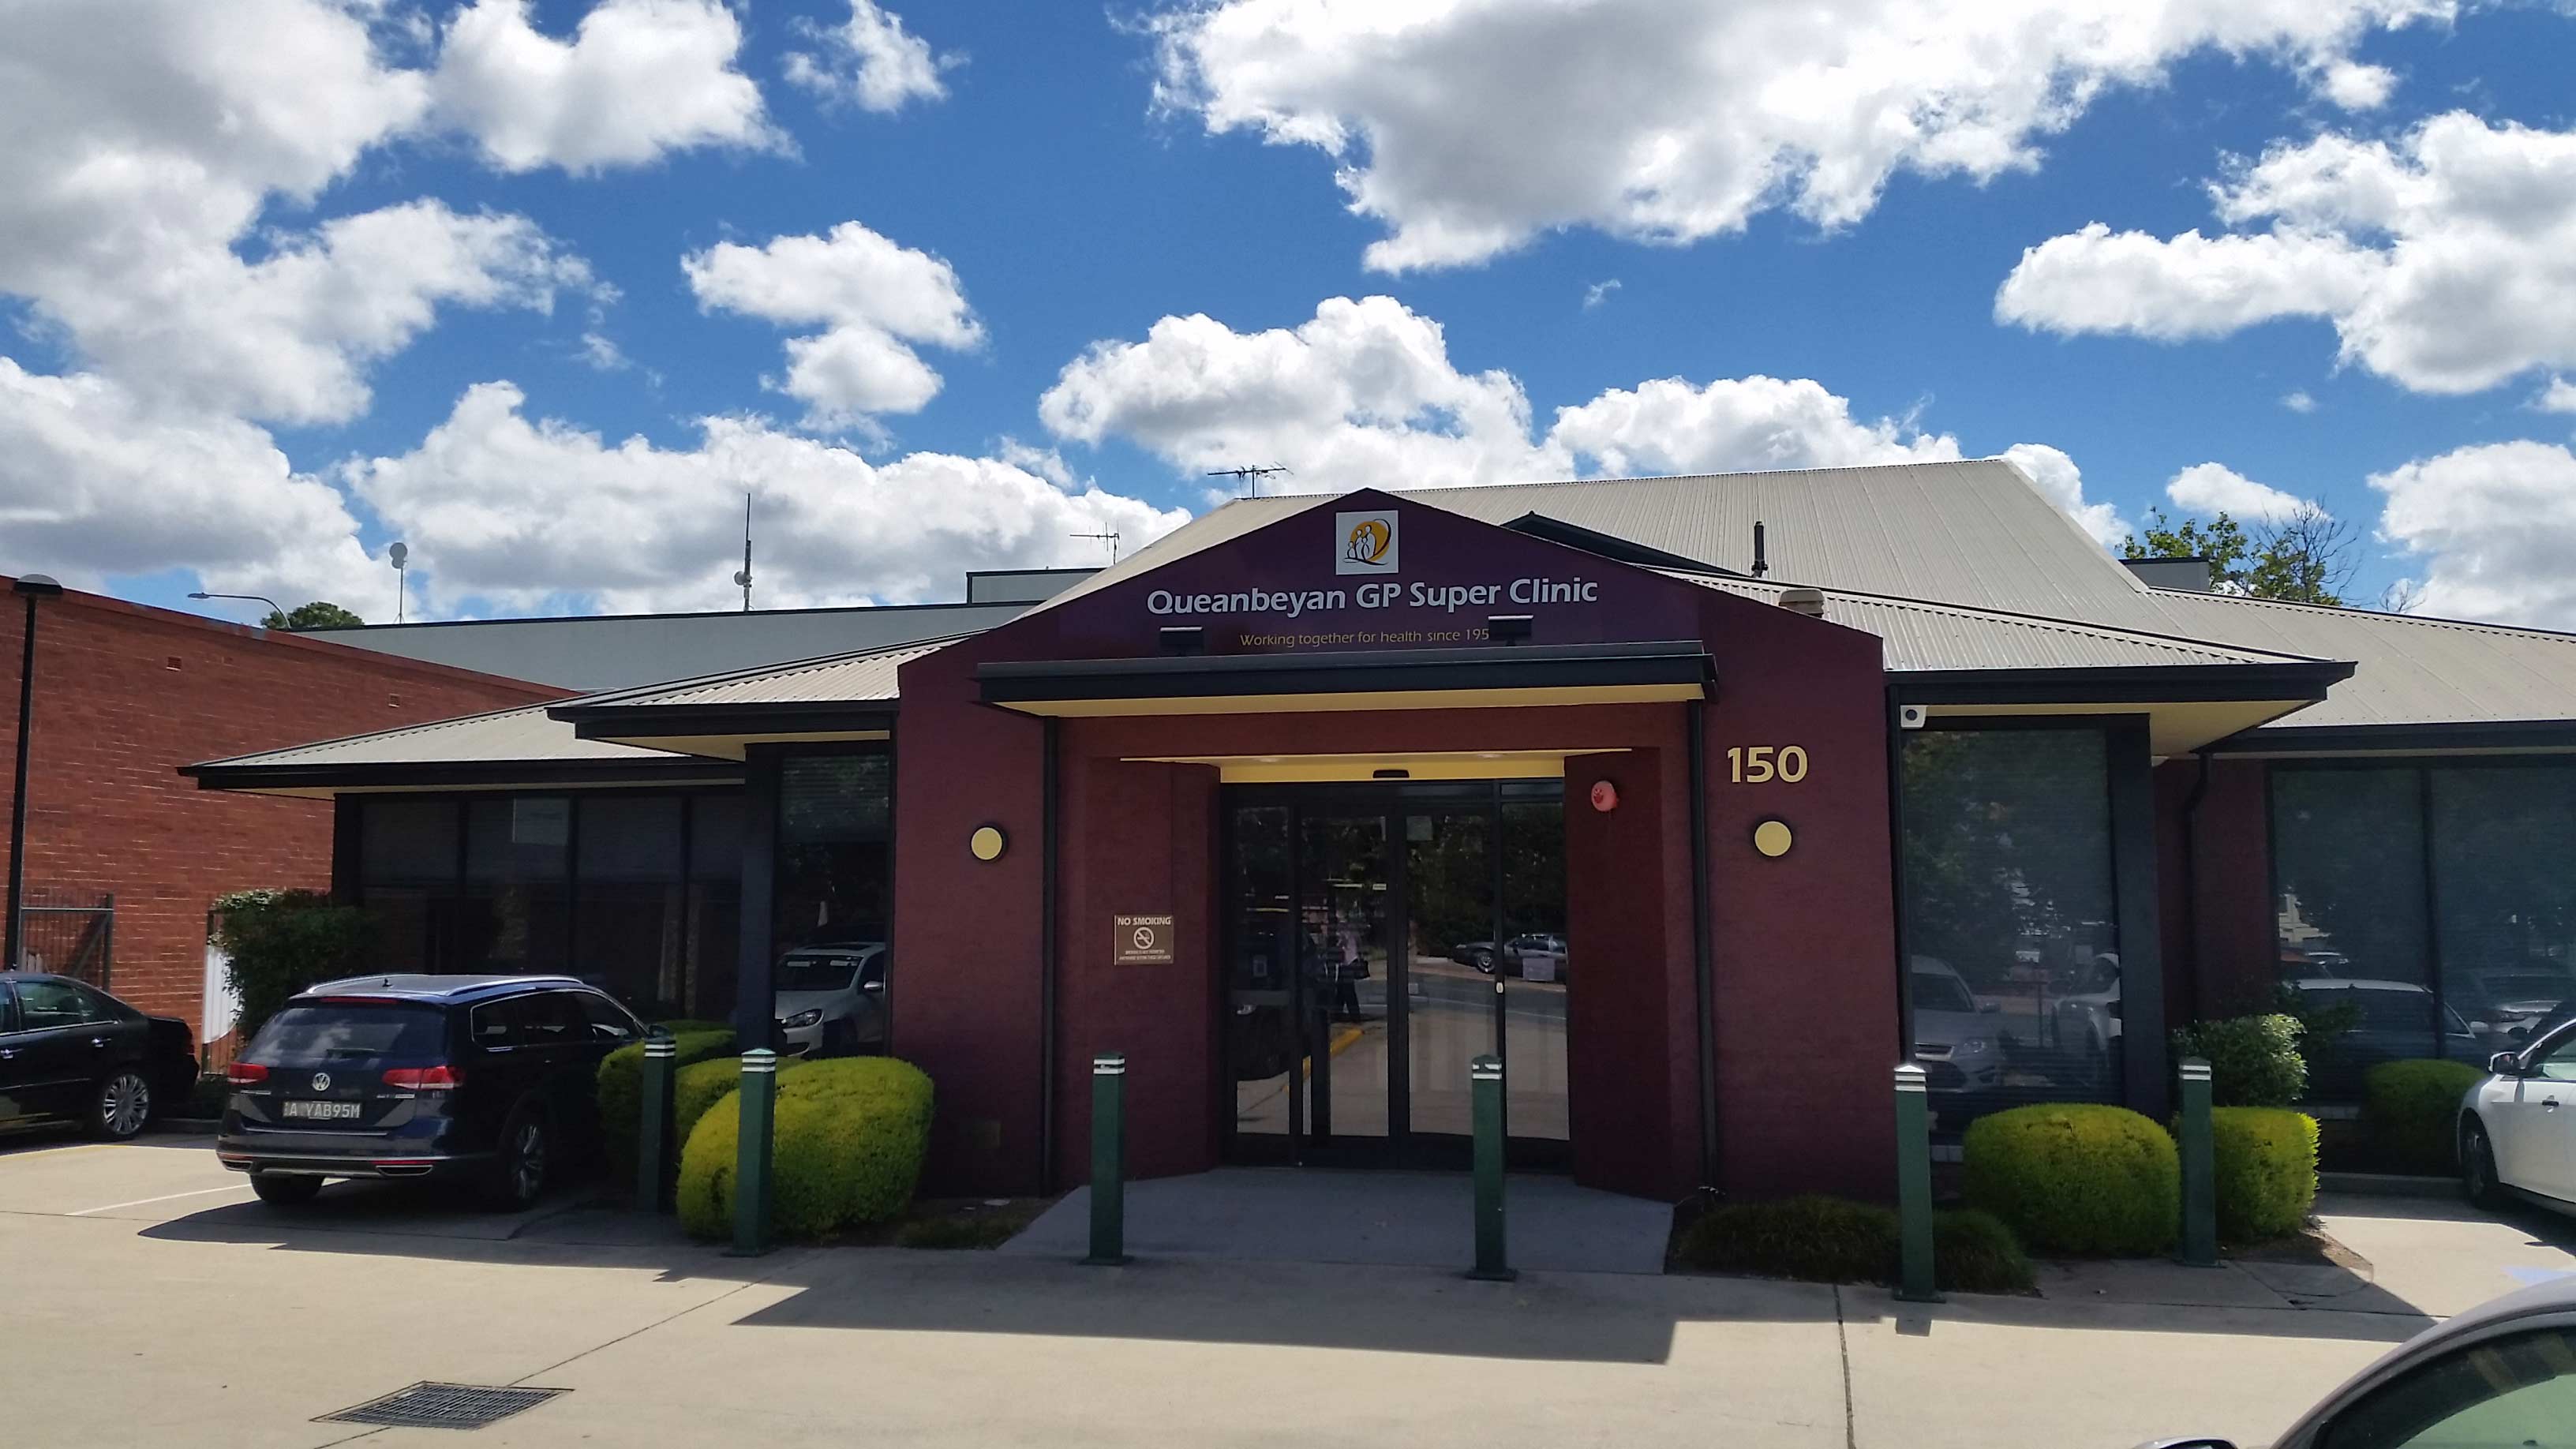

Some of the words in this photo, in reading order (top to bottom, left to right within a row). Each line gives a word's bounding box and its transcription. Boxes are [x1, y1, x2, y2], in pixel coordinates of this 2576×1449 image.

[1147, 587, 1346, 619] Queanbeyan
[1355, 582, 1402, 609] GP
[1409, 581, 1502, 613] Super
[1508, 576, 1598, 604] Clinic
[1240, 634, 1295, 648] Working
[1298, 632, 1355, 647] together
[1358, 631, 1376, 643] for
[1380, 631, 1422, 643] health
[1427, 630, 1461, 642] since
[1466, 627, 1489, 641] 195
[1727, 745, 1809, 783] 150
[1117, 917, 1132, 926] NO
[1133, 916, 1172, 926] SMOKING
